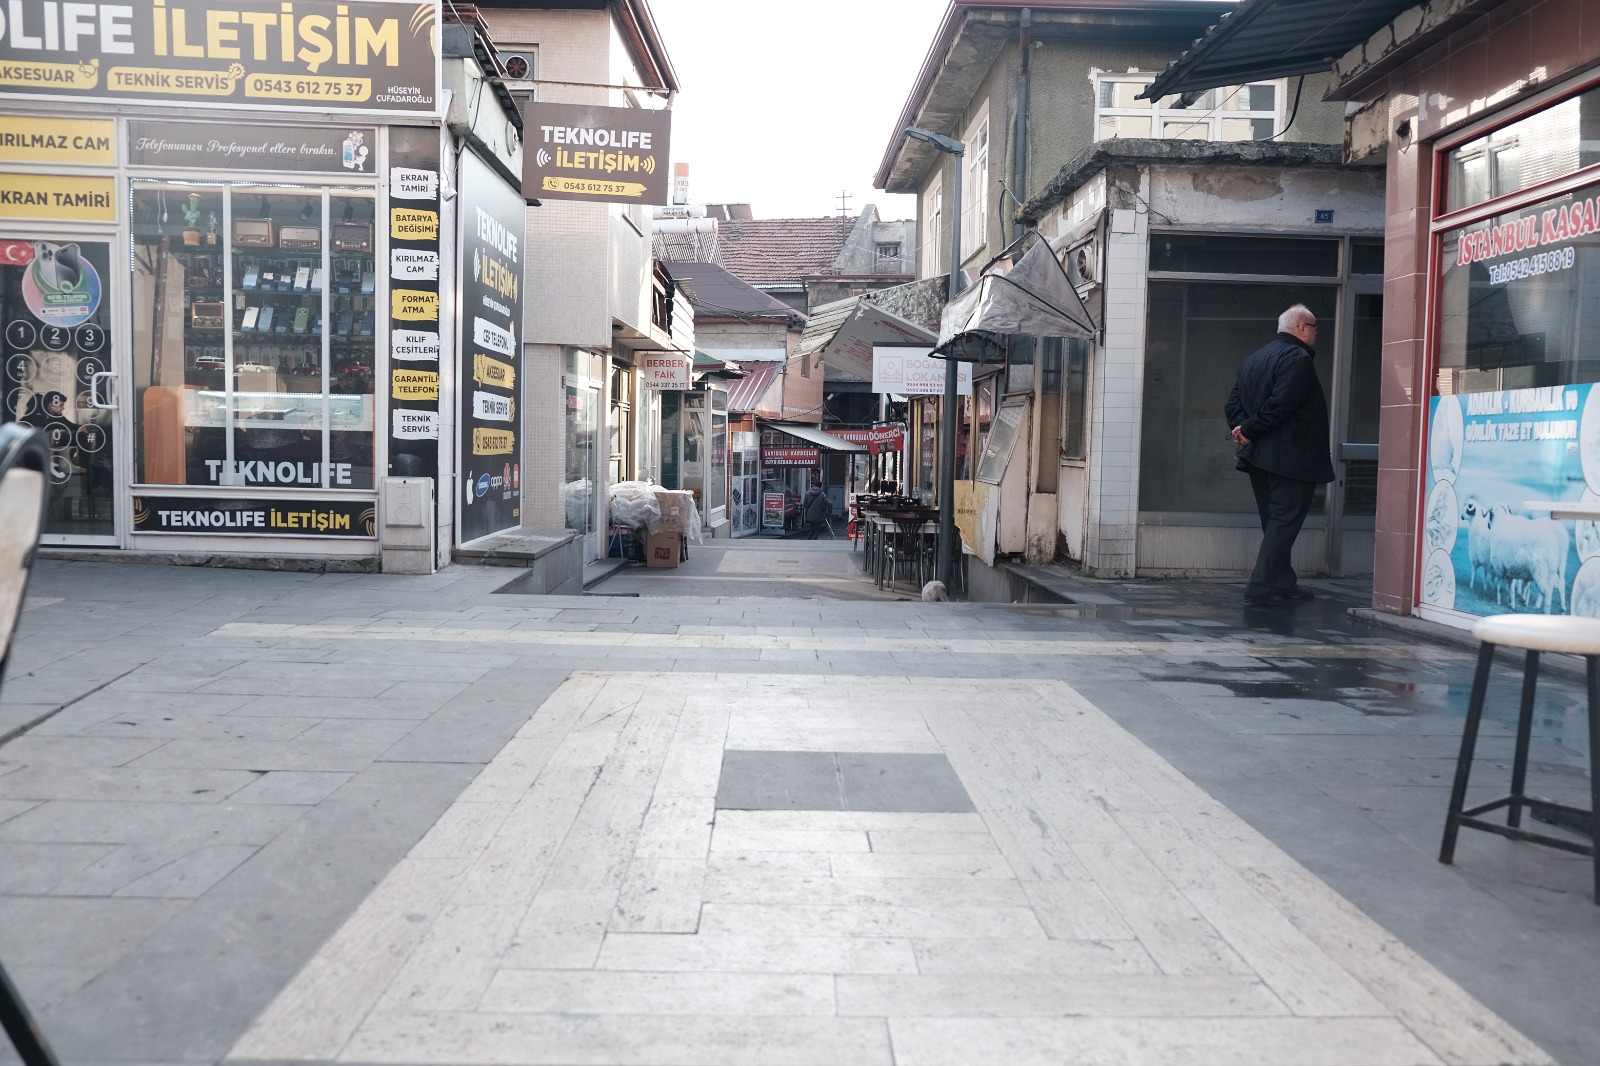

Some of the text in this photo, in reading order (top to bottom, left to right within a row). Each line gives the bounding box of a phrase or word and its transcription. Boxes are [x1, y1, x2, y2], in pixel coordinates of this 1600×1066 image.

[0, 0, 399, 73] LIFE İLETİŞİM
[114, 71, 229, 90] TEKNİK SERVİS
[253, 78, 363, 96] 0543 612 75 37
[388, 86, 421, 95] HÜSEYİN
[376, 94, 433, 104] ÇUFADAROĞLU
[72, 136, 110, 151] CAM
[540, 125, 652, 150] TEKNOLIFE
[135, 137, 203, 155] Telefonunuzu
[206, 139, 267, 158] Profesyonel
[269, 142, 297, 154] ellere
[555, 146, 640, 174] İLETİŞİM
[400, 174, 429, 182] EKRAN
[400, 182, 429, 193] TAMİRİ
[564, 182, 626, 193] 0543 612 75 37
[1, 190, 110, 208] KRAN TAMİRİ
[395, 214, 433, 222] BATARYA
[1319, 212, 1329, 220] 45
[398, 223, 434, 234] DEĞİŞİMİ
[476, 205, 518, 264] TEKNOLIFE
[1457, 215, 1538, 265] İSTANBUL
[395, 255, 435, 263] KIRILMAZ
[1529, 251, 1547, 276] 415
[1547, 249, 1562, 272] 88
[1561, 246, 1576, 269] 19
[406, 265, 425, 273] CAM
[481, 246, 513, 300] İLETİŞİM
[401, 295, 436, 303] FORMAT
[401, 306, 425, 314] ATMA
[18, 326, 25, 339] 1
[51, 327, 61, 341] 2
[85, 329, 95, 342] 3
[406, 335, 427, 343] KILIF
[395, 345, 437, 355] ÇEŞİTLERİ
[16, 359, 26, 372] 4
[85, 362, 95, 375] 6
[646, 359, 684, 368] BERBER
[394, 374, 438, 383] GARANTİLİ
[654, 369, 676, 379] FAİK
[906, 371, 967, 383] LOKANSI
[397, 385, 435, 394] TELEFON
[52, 394, 60, 407] 8
[401, 413, 432, 423] TEKNİK
[52, 428, 61, 441] 0
[401, 424, 431, 433] SERVİS
[868, 426, 901, 440] DÖNERCİ
[1498, 422, 1520, 441] TAZE
[1520, 422, 1534, 441] ET
[158, 508, 351, 531] TEKNOLIFE İLETİŞİM
